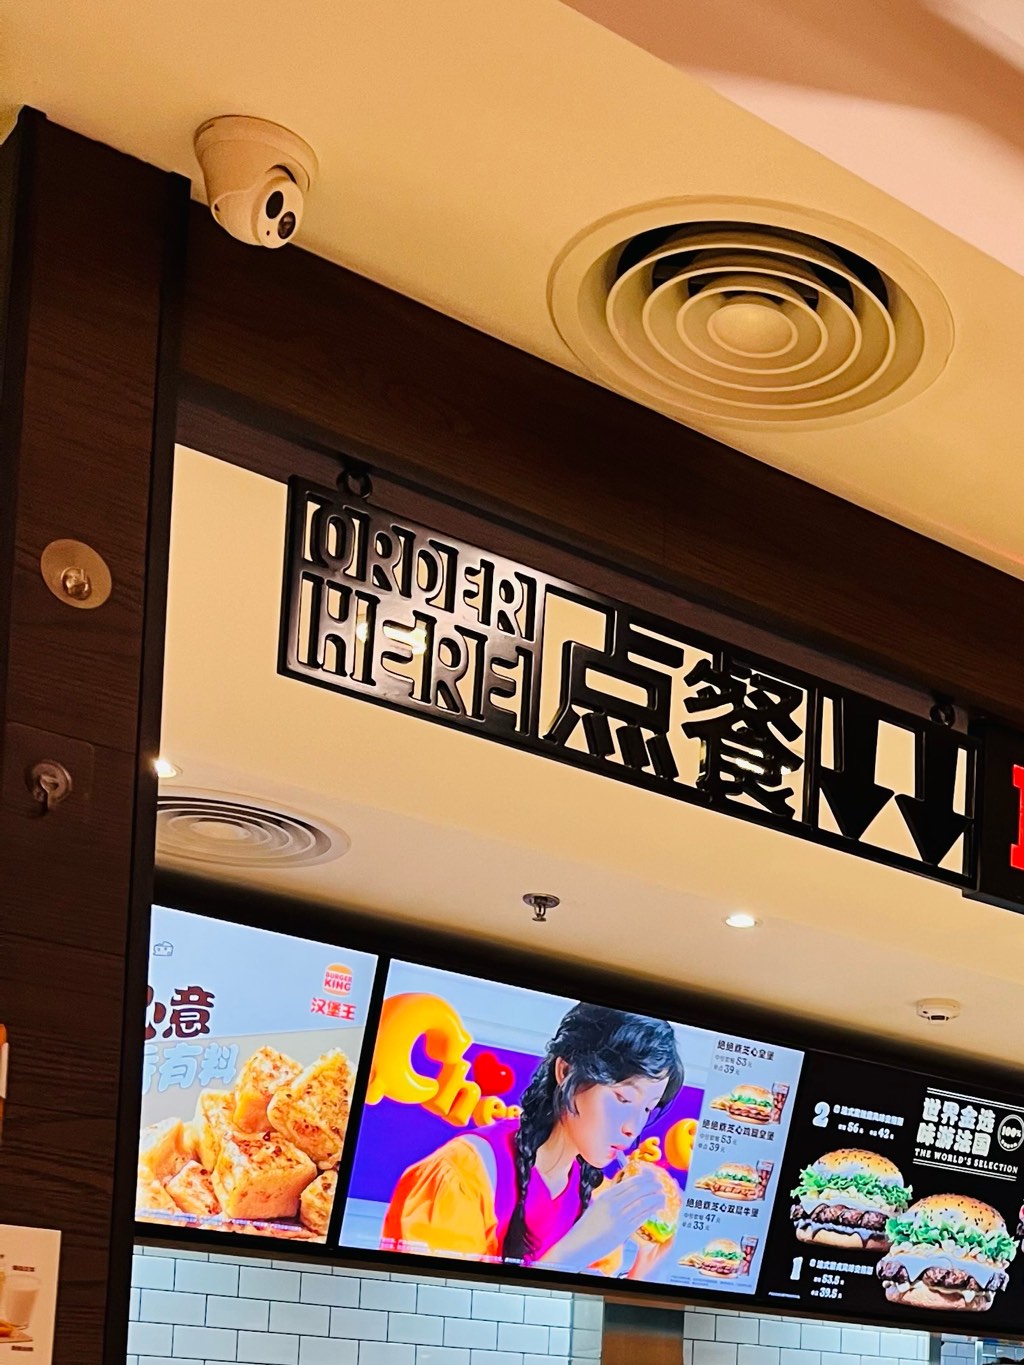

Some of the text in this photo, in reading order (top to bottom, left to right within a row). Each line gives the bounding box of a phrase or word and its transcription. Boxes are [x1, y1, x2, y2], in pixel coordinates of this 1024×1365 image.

[304, 496, 536, 642] ORDER
[299, 574, 531, 736] HERE
[544, 606, 804, 817] 点餐
[324, 978, 352, 992] KING
[325, 971, 352, 983] BURGER
[310, 997, 357, 1021] 汉堡王
[812, 1101, 831, 1128] 2
[922, 1097, 996, 1134] 世界金选
[916, 1122, 992, 1157] 味游法国
[915, 1148, 1019, 1175] THE WORLD'S SELECTION
[790, 1256, 804, 1281] 1
